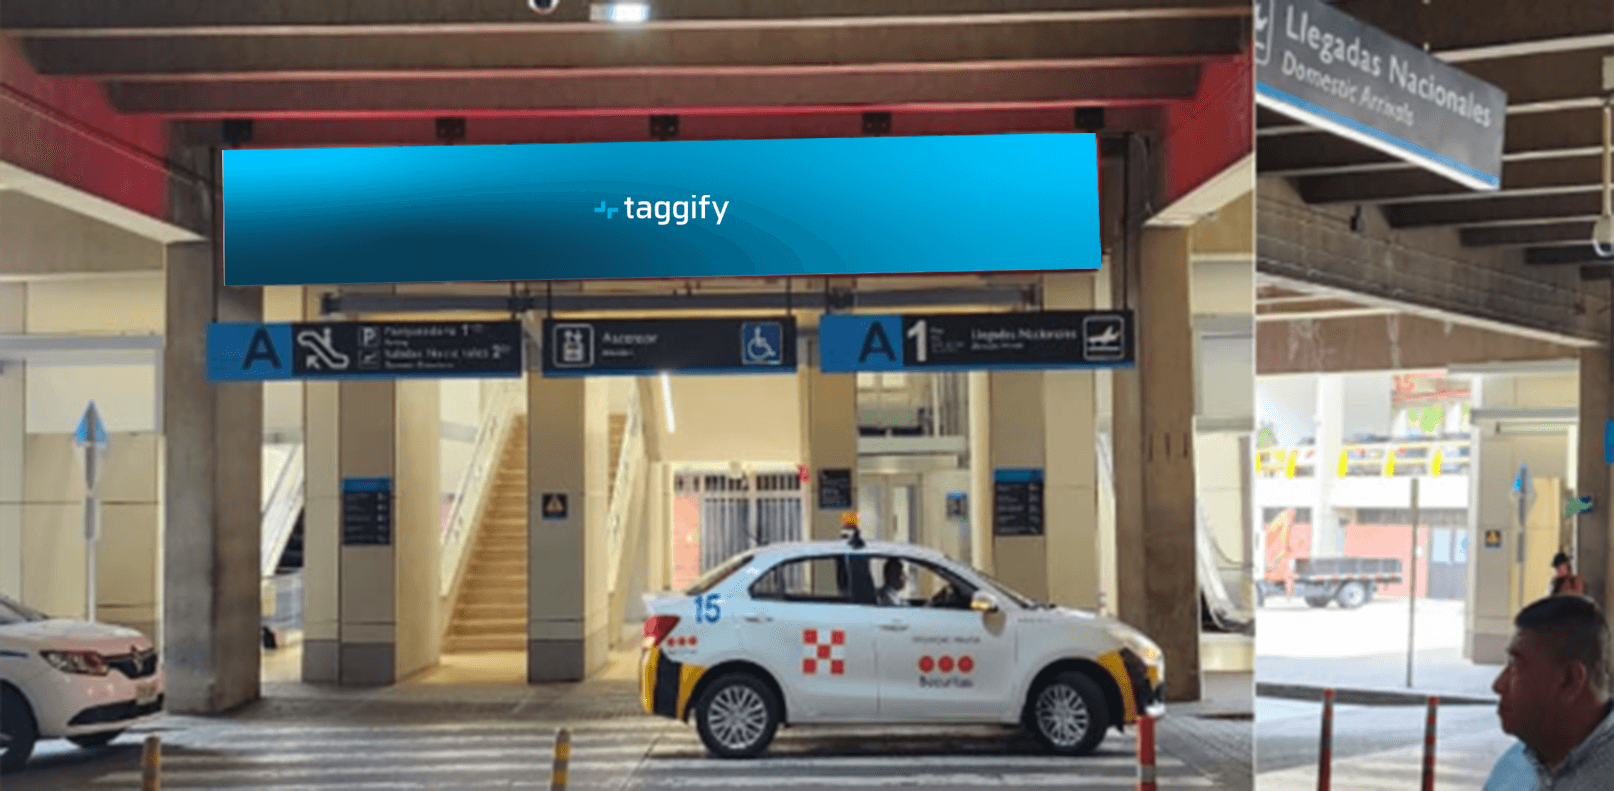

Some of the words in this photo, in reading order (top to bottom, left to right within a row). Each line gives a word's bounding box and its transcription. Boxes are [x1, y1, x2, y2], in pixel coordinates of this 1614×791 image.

[1286, 5, 1382, 77] Llegadas
[1389, 55, 1492, 127] Nacionales
[1281, 50, 1358, 104] Domestic
[1359, 85, 1415, 127] Arrivals
[624, 194, 730, 225] taggify
[241, 326, 283, 370] A
[857, 320, 898, 364] A
[907, 320, 927, 362] 1
[694, 593, 722, 624] 15
